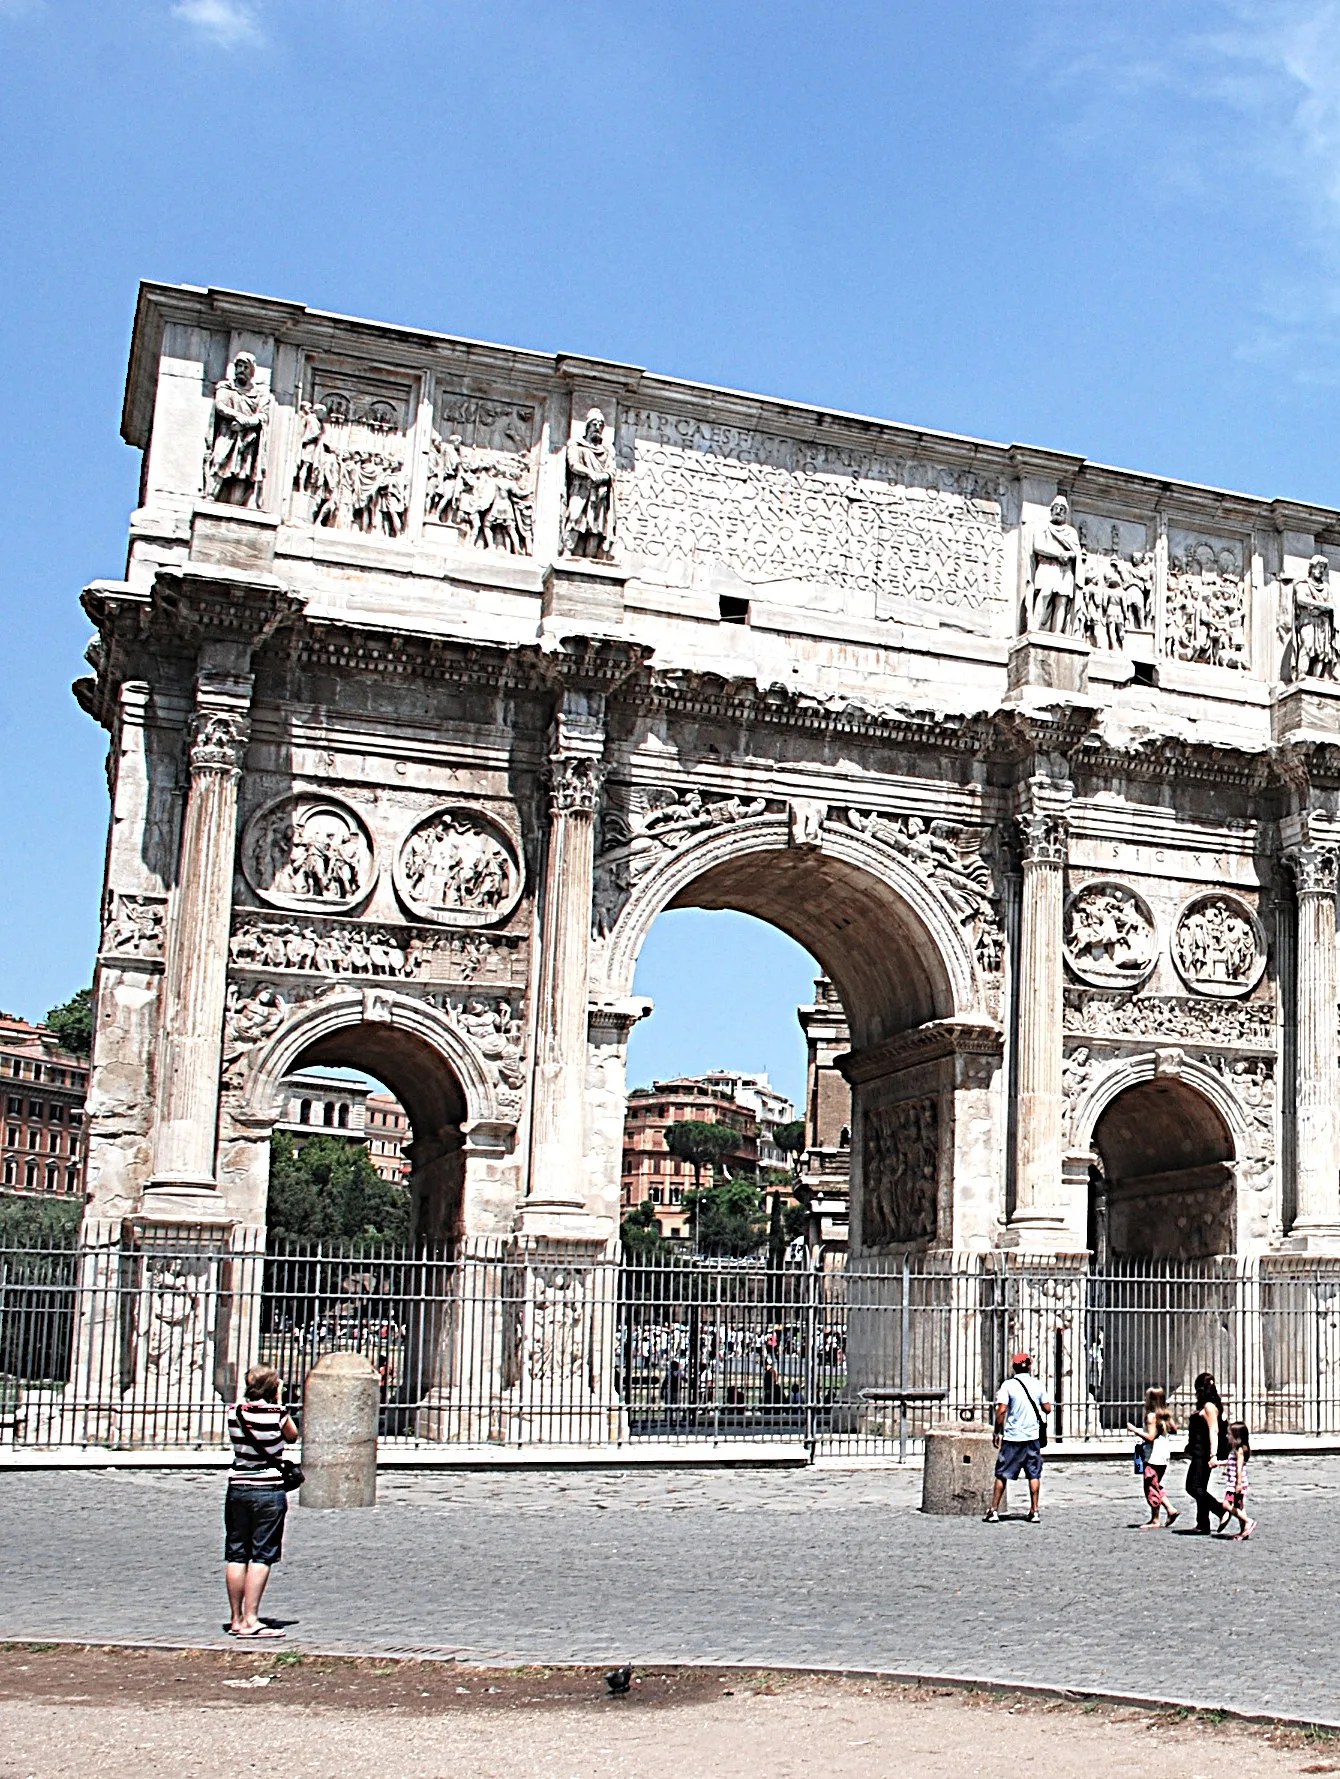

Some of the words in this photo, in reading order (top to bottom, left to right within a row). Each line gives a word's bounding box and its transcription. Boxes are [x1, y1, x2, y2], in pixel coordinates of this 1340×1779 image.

[621, 408, 668, 432] IMP
[674, 418, 731, 444] CAES
[701, 441, 816, 477] AVGVO
[964, 524, 1004, 546] SVO
[1112, 845, 1165, 863] SIC
[1193, 854, 1222, 870] XX
